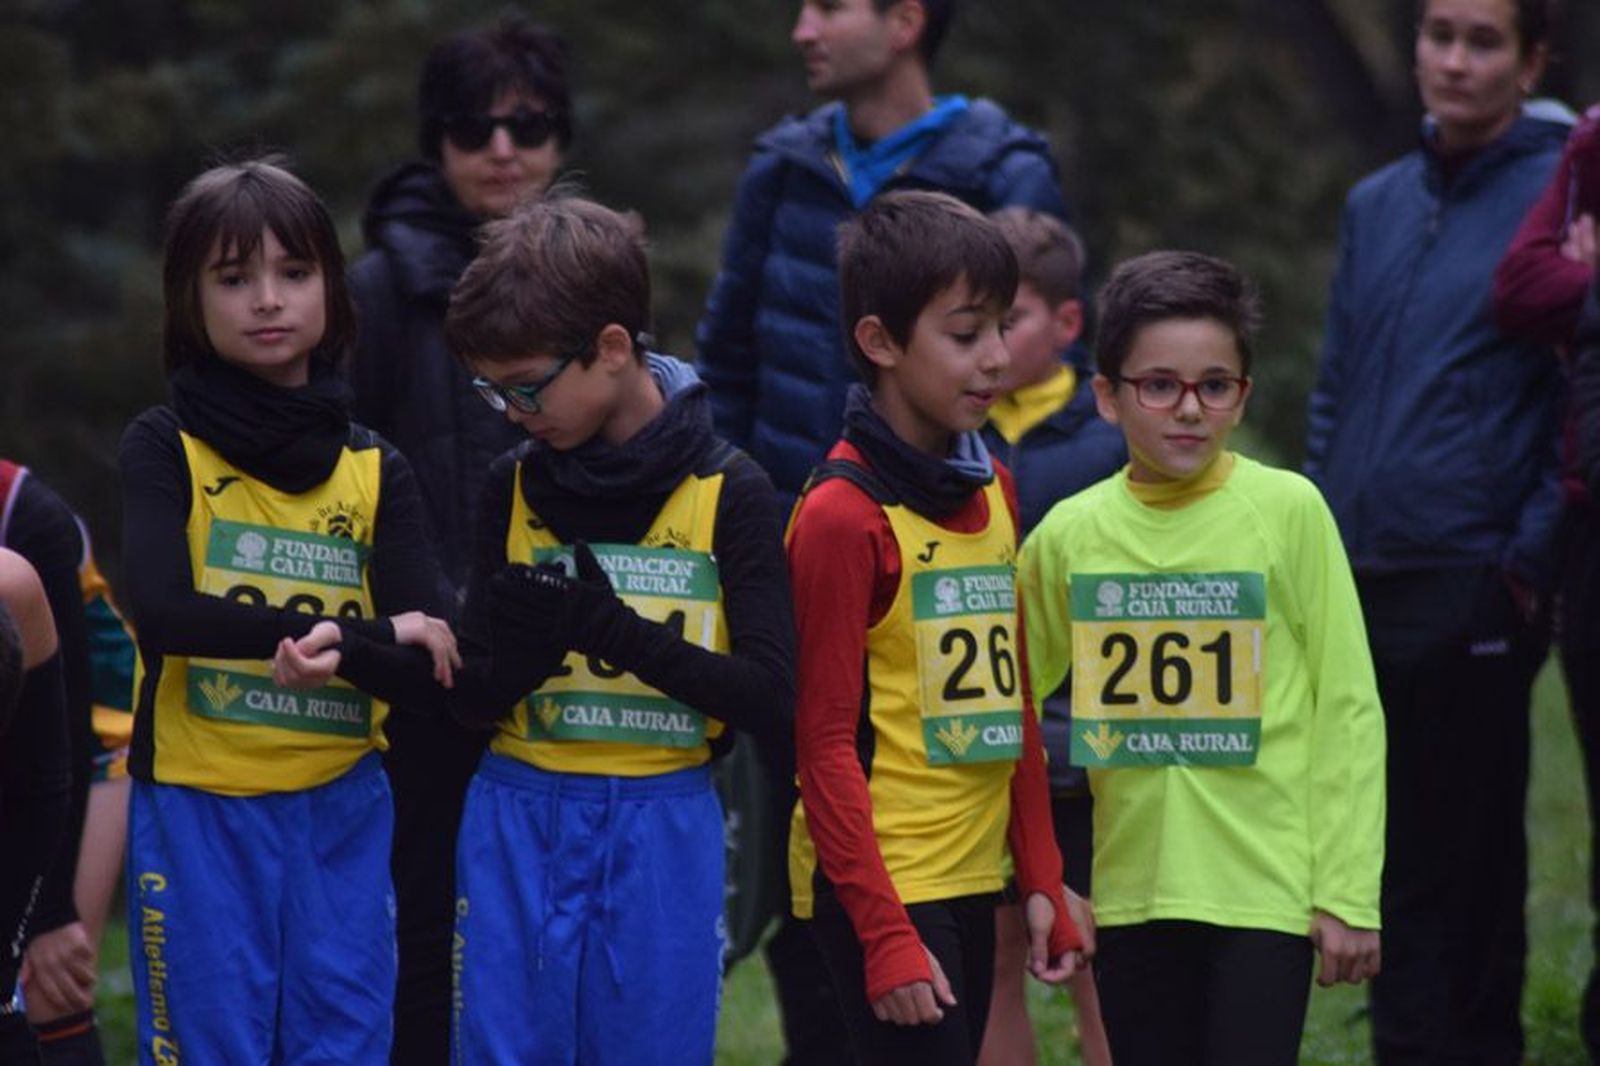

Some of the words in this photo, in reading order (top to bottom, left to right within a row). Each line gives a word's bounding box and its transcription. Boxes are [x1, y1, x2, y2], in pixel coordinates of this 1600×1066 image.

[271, 556, 316, 579] CAJA
[626, 574, 691, 594] RURAL
[1128, 581, 1239, 599] FUNDACION
[1127, 600, 1169, 616] CAJA
[1175, 600, 1239, 616] RURAL
[1101, 631, 1233, 705] 261
[245, 689, 300, 716] CAJA
[305, 698, 363, 723] RURAL
[563, 705, 614, 727] CAJA
[621, 709, 695, 733] RURAL
[1126, 732, 1174, 752] CAJA
[1180, 732, 1253, 752] RURAL
